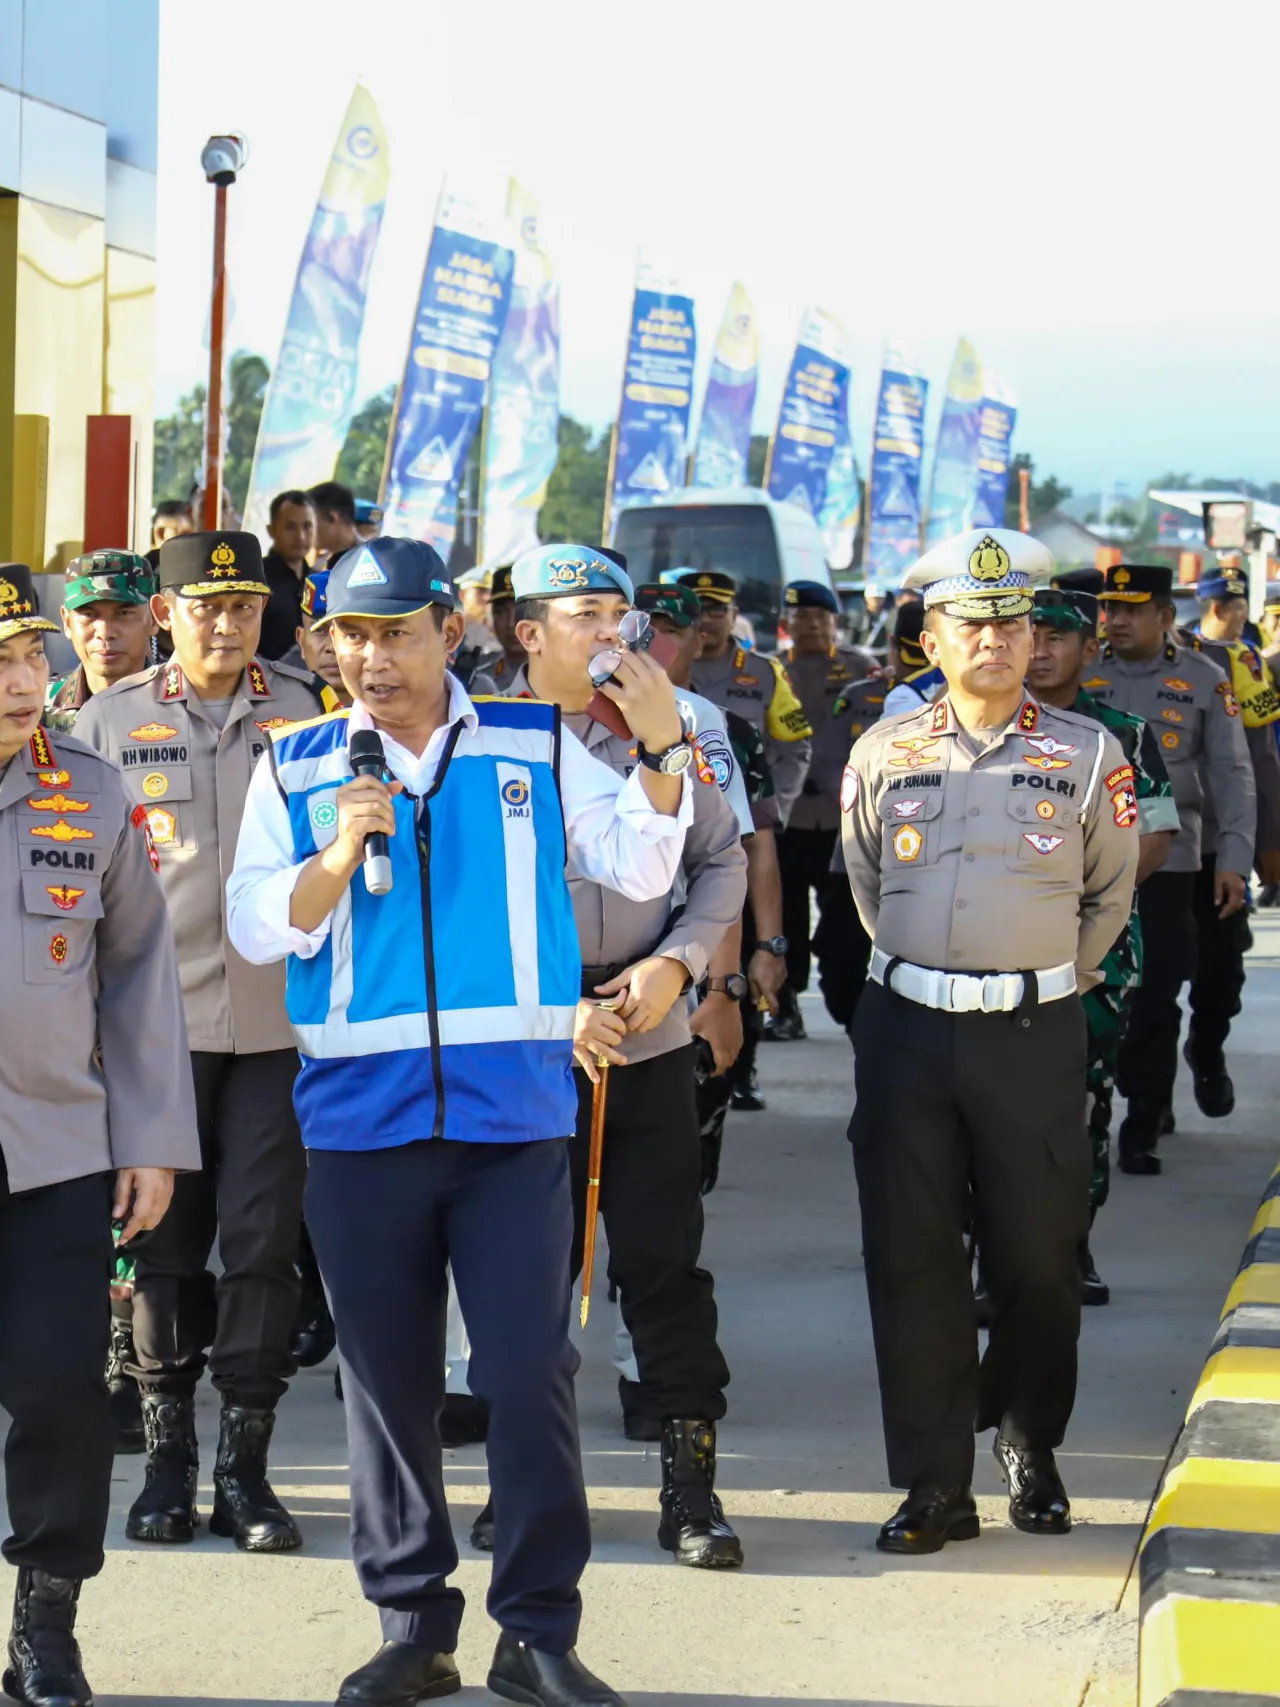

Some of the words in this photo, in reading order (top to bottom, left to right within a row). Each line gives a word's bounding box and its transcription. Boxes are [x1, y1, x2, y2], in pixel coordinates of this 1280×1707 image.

[1156, 691, 1194, 704] POLRI
[122, 749, 137, 767] RH
[138, 746, 188, 764] WIBOWO
[1011, 773, 1076, 799] POLRI
[506, 807, 530, 818] JMJ
[30, 849, 95, 871] POLRI
